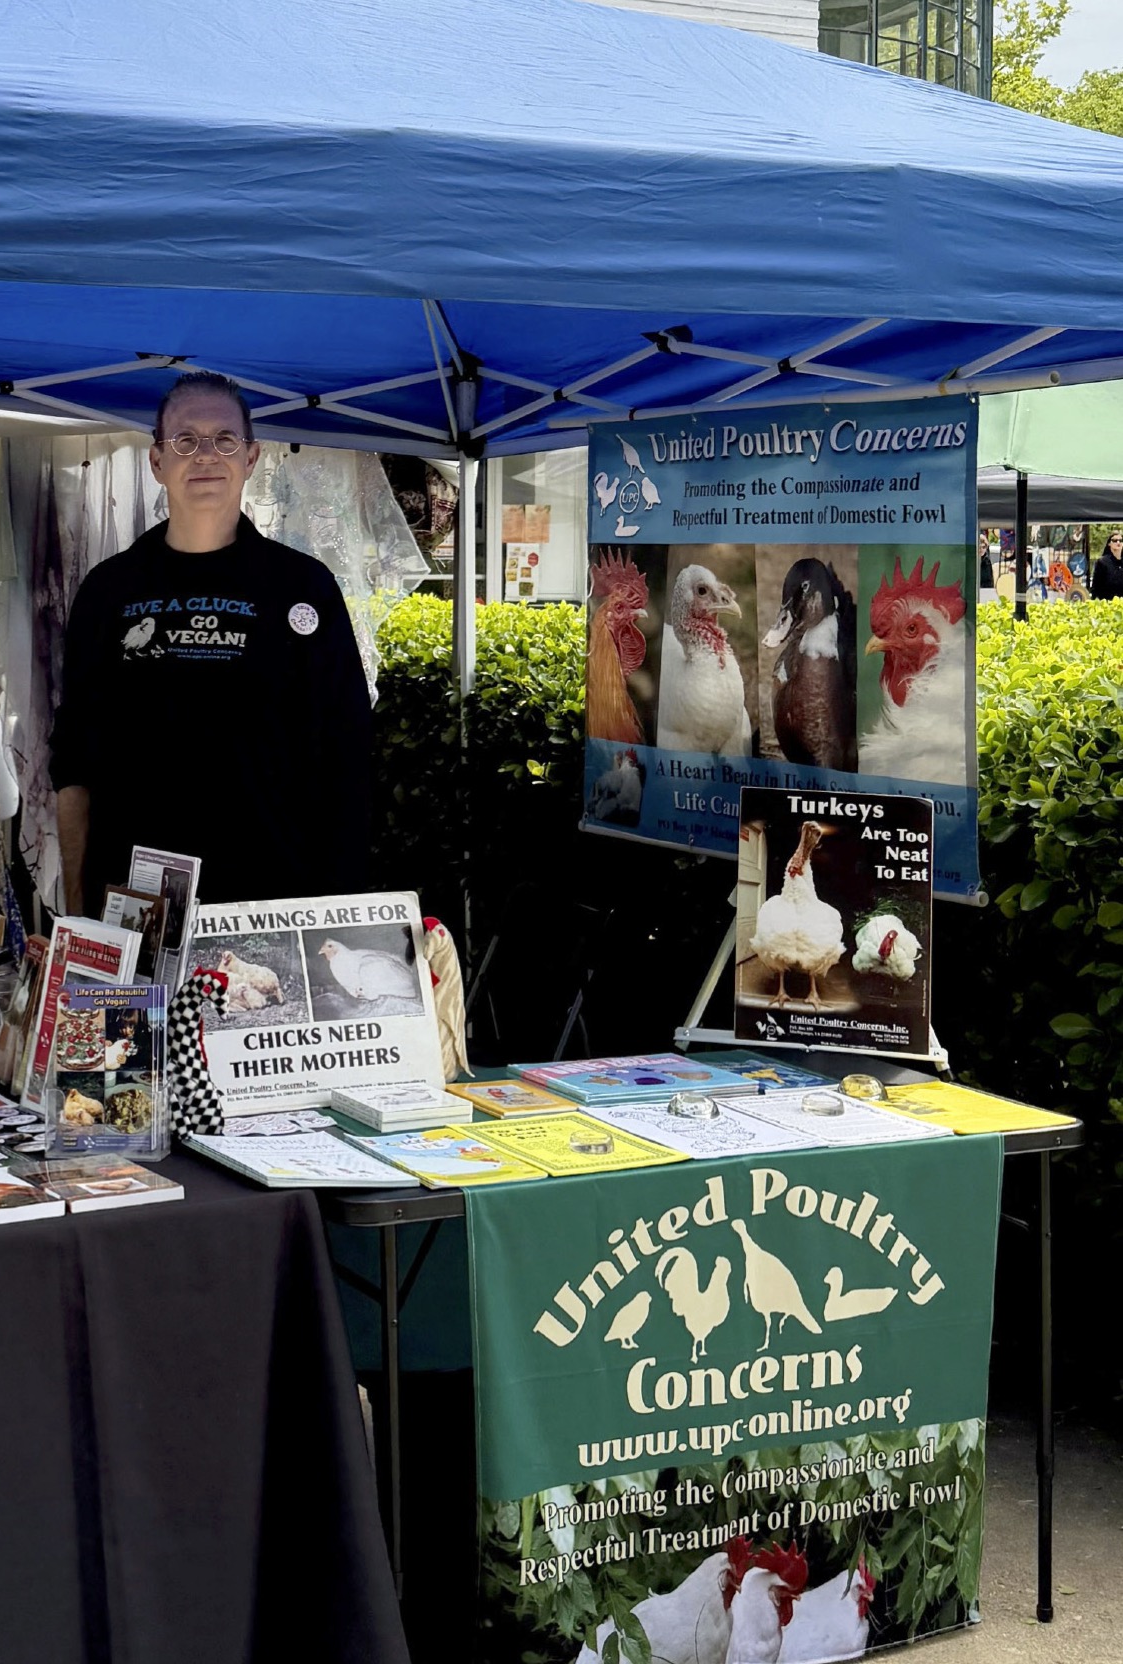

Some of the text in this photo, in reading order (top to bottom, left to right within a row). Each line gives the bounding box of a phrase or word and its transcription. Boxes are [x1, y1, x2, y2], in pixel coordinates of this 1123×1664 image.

[649, 418, 968, 464] United Poultry Concerns
[684, 472, 920, 500] Promoting the Compassionate and
[673, 504, 946, 529] Respectful Treatment of Domestic Fowl
[166, 599, 182, 611] A
[186, 597, 257, 616] CLUCK.
[190, 615, 218, 629] GO
[166, 630, 247, 647] VEGAN!
[656, 759, 665, 776] A
[670, 760, 715, 780] Heart
[722, 765, 760, 786] Beats
[764, 770, 779, 788] in
[674, 791, 739, 817] Life Can
[787, 796, 885, 823] Turkeys
[861, 826, 928, 843] Are Too
[885, 846, 929, 862] Neat
[875, 865, 929, 882] To Eat
[247, 910, 317, 932] WINGS
[323, 907, 362, 925] ARE
[368, 904, 408, 921] FOR
[75, 988, 148, 996] Life Can Be Beautiful
[105, 998, 130, 1006] Vegan!
[243, 1022, 382, 1051] CHICKS NEED
[790, 1014, 817, 1025] United
[819, 1017, 848, 1028] Poultry
[893, 1023, 909, 1033] Inc.
[229, 1046, 401, 1078] THEIR MOTHERS
[226, 1087, 247, 1095] United
[250, 1085, 272, 1093] Poultry
[533, 1168, 946, 1347] United Poultry
[627, 1344, 863, 1415] Concerns
[578, 1389, 912, 1468] www.upc-online.org
[543, 1437, 936, 1532] Promoting the Compassionate and
[519, 1476, 961, 1586] Respectful Treatment of Domestic Fowl
